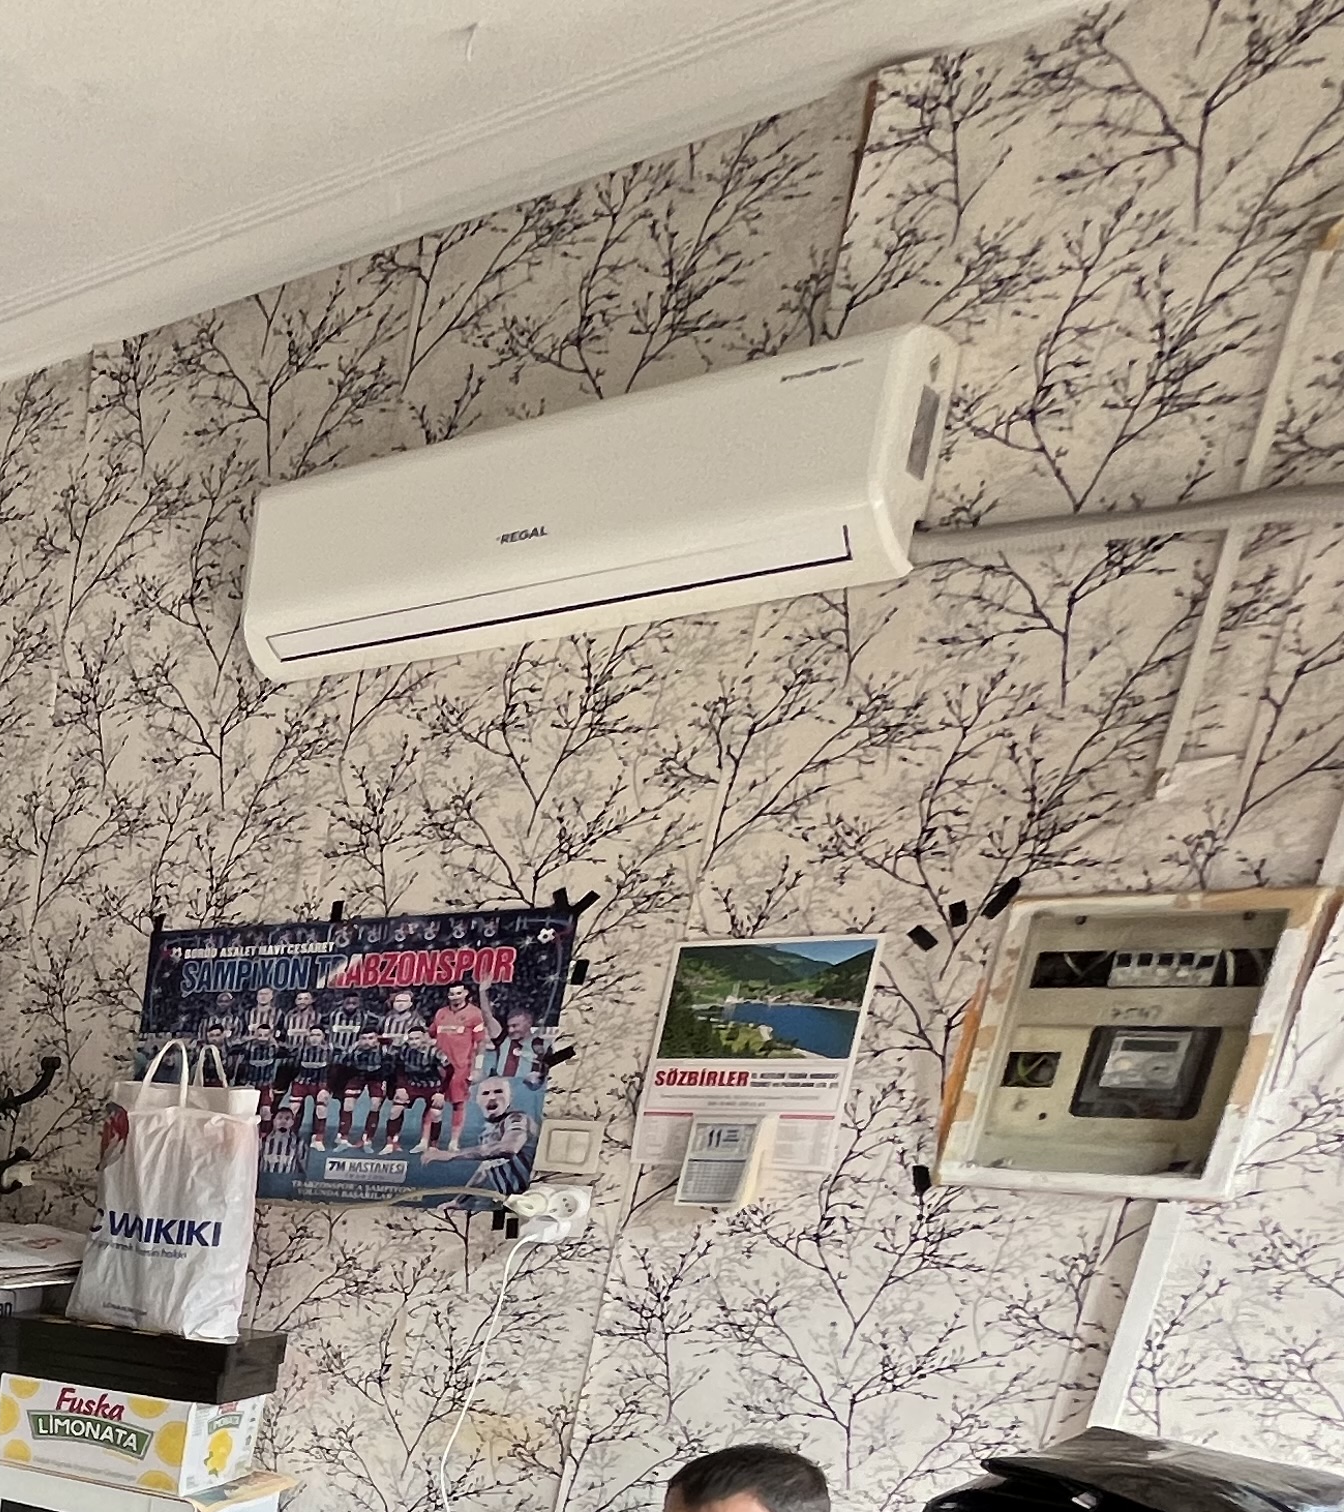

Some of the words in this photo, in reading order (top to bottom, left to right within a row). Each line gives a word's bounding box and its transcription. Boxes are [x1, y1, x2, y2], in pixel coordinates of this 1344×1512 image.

[500, 526, 548, 545] REGAL
[315, 946, 517, 990] TRABZONSPOR
[654, 1067, 750, 1087] SÖZBİRLER
[55, 1387, 125, 1422] Fuska
